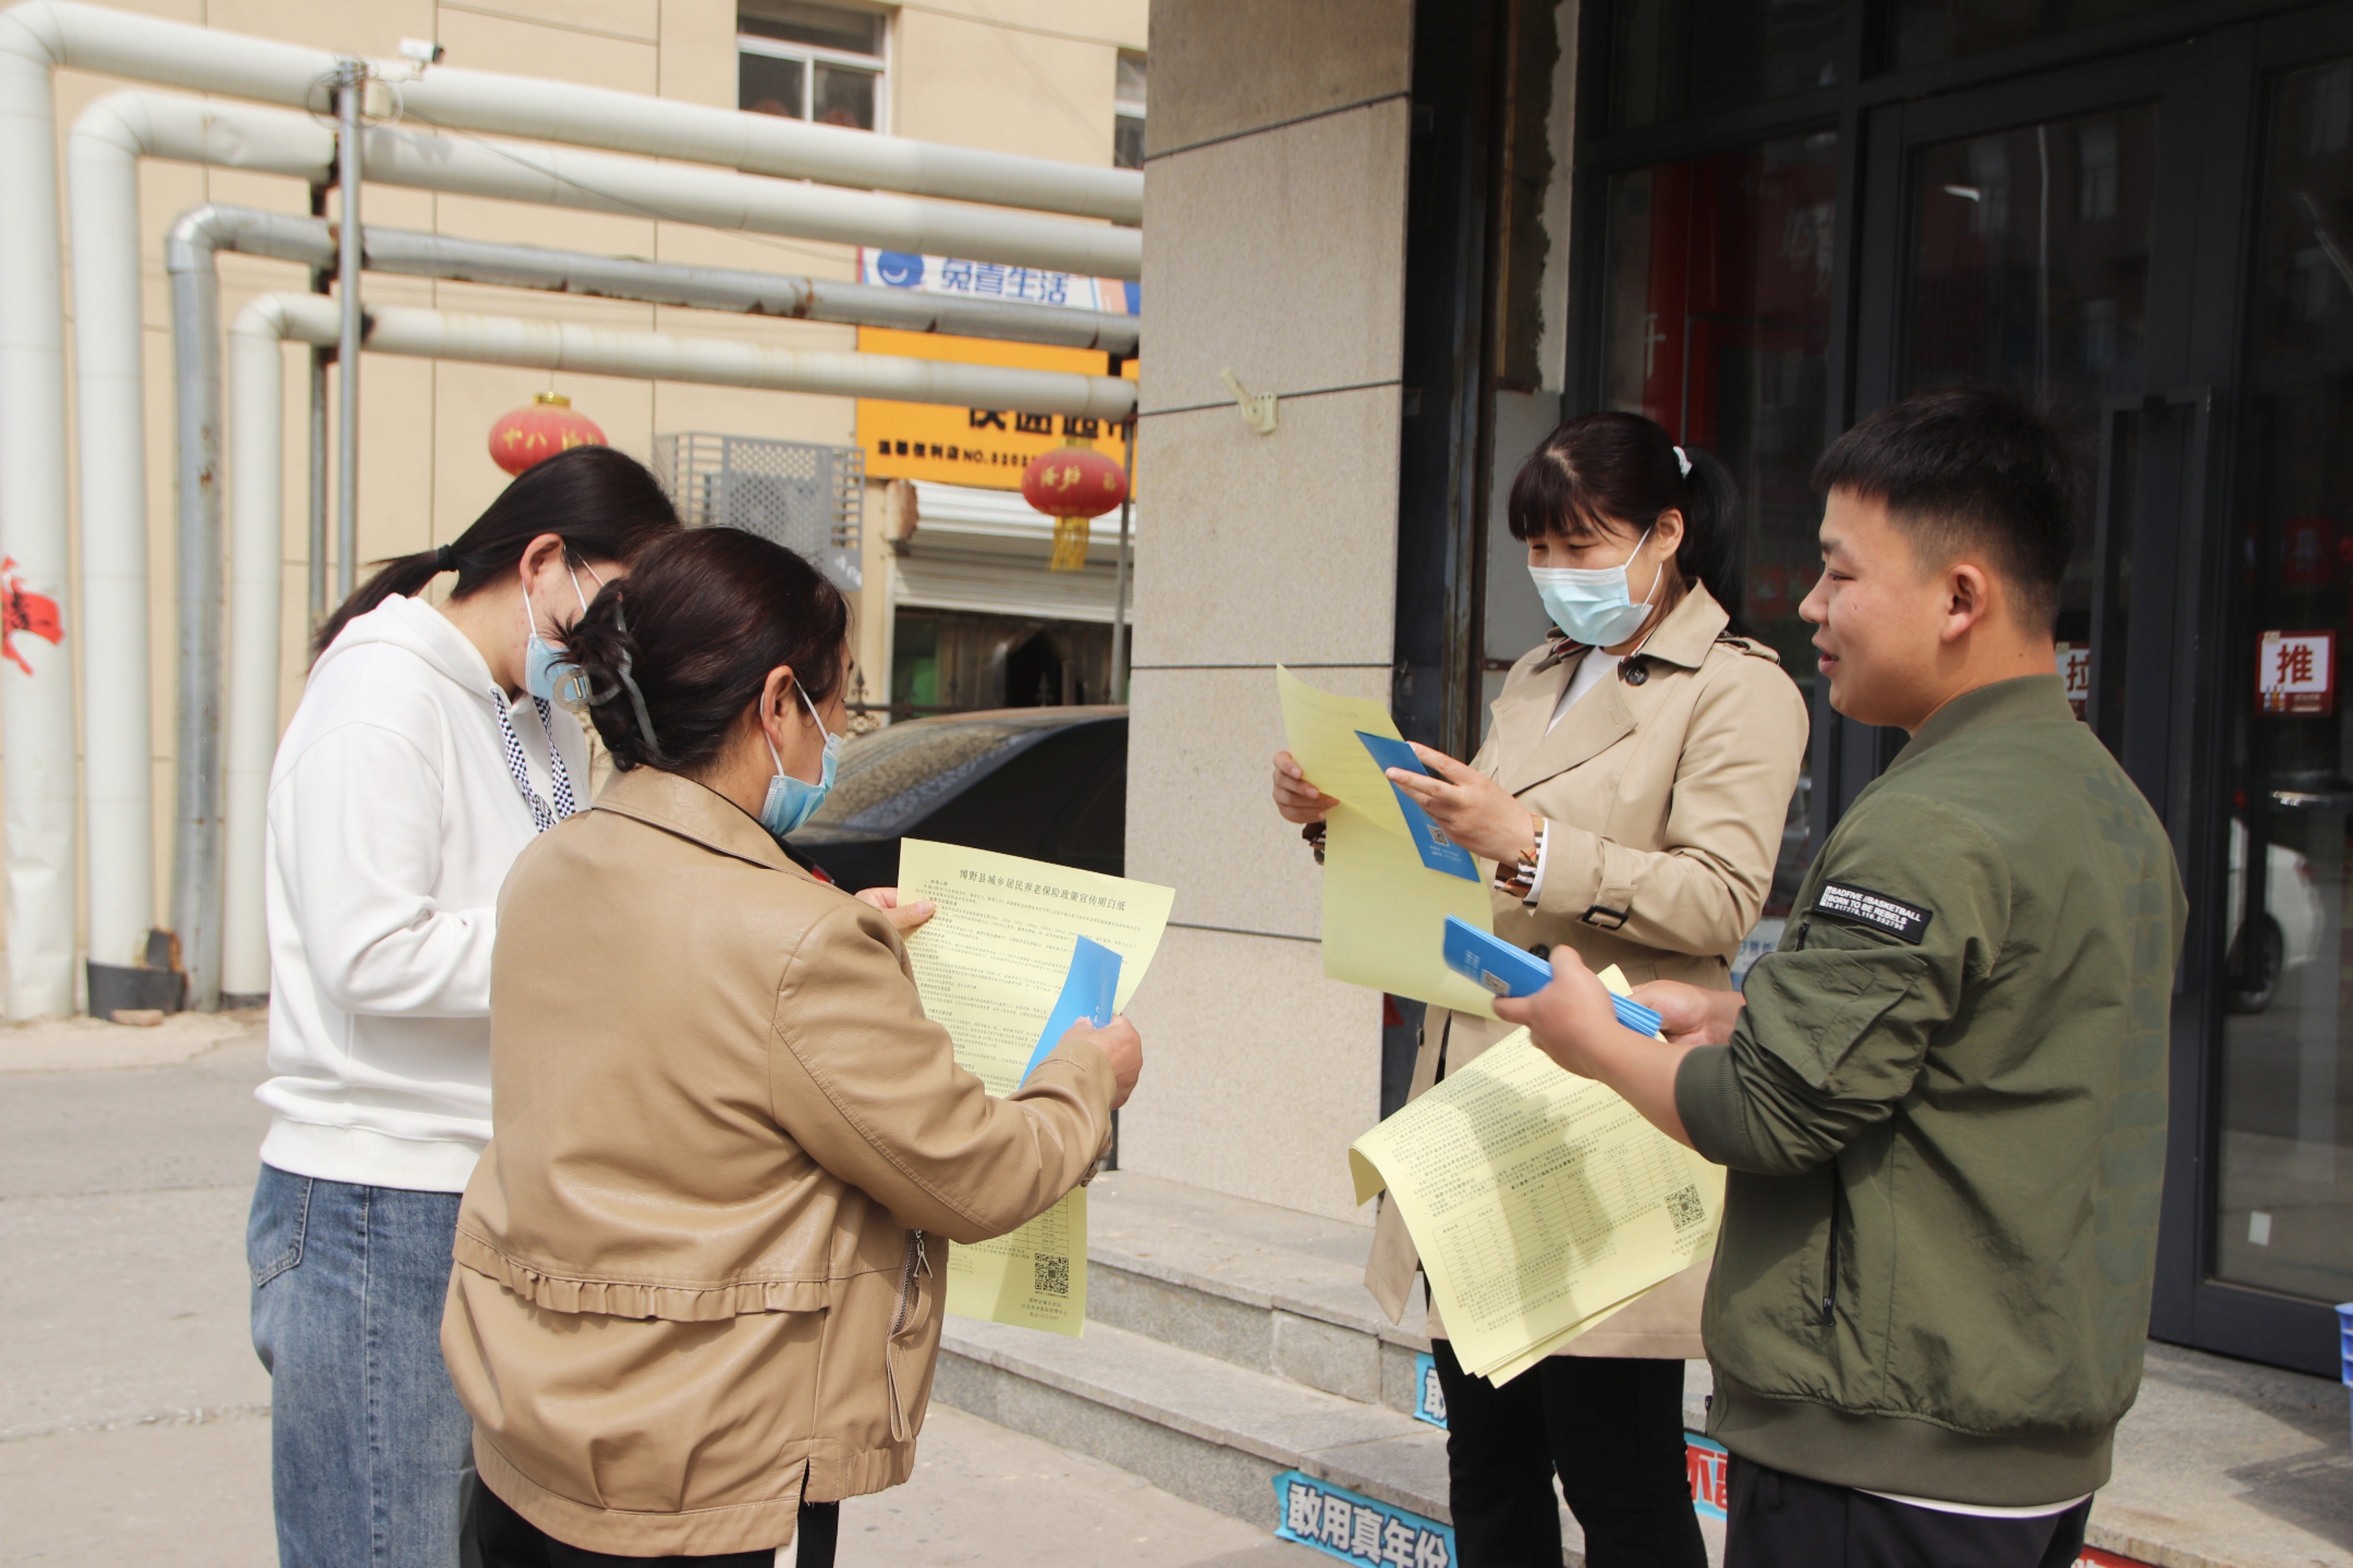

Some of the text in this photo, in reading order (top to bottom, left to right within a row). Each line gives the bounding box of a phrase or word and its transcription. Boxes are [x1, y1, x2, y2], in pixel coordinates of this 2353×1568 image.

[2277, 644, 2314, 685] 推
[1850, 900, 1861, 909] TO
[1861, 903, 1874, 913] BE
[1874, 907, 1908, 925] REBELS
[1287, 1479, 1450, 1568] 敢用真年份
